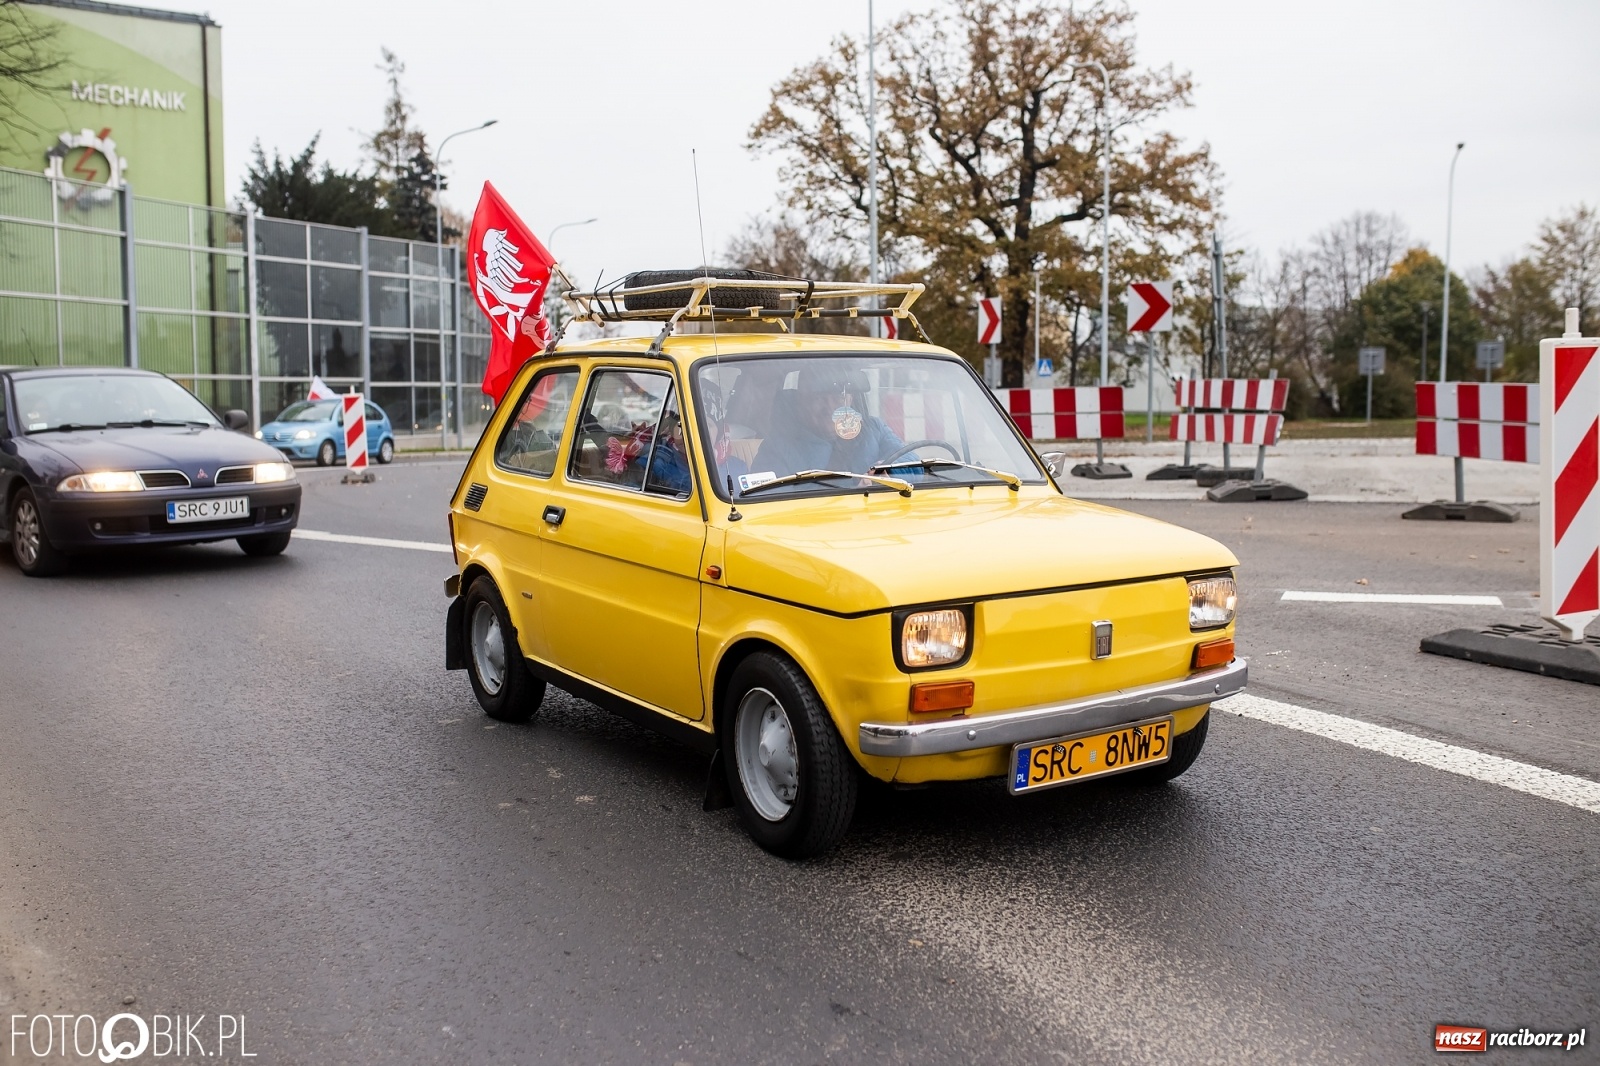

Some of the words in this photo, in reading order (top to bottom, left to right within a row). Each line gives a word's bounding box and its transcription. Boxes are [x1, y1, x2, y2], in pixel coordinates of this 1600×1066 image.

[71, 79, 186, 112] MECHANIK
[177, 503, 208, 518] SRC
[212, 499, 245, 516] 9JU1
[1031, 741, 1084, 782] SRC
[1105, 723, 1167, 767] 8NW5
[1016, 773, 1026, 783] PL
